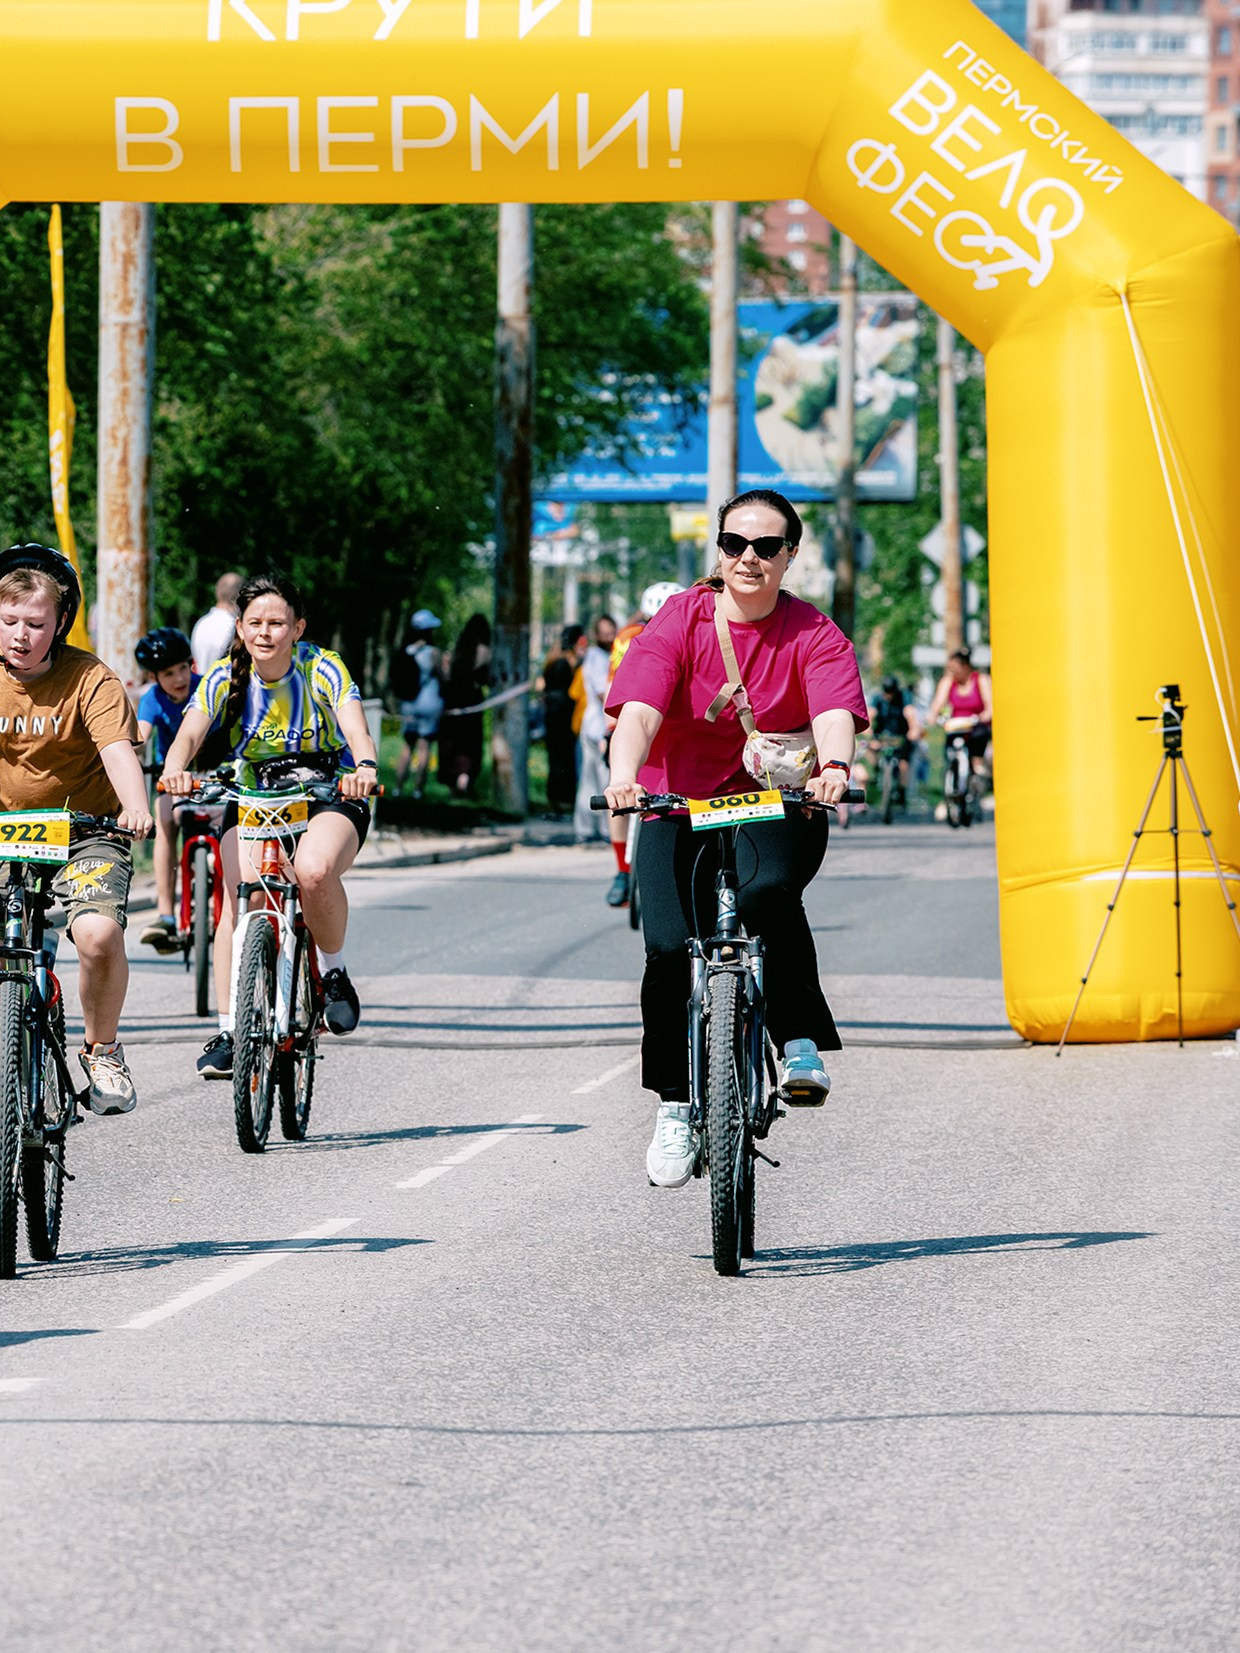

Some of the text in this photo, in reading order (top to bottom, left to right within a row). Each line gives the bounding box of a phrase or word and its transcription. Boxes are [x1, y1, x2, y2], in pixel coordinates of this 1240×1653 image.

[115, 88, 684, 172] В ПЕРМИ!
[943, 40, 1124, 194] ПЕРМСКИЙ
[0, 824, 48, 842] 922
